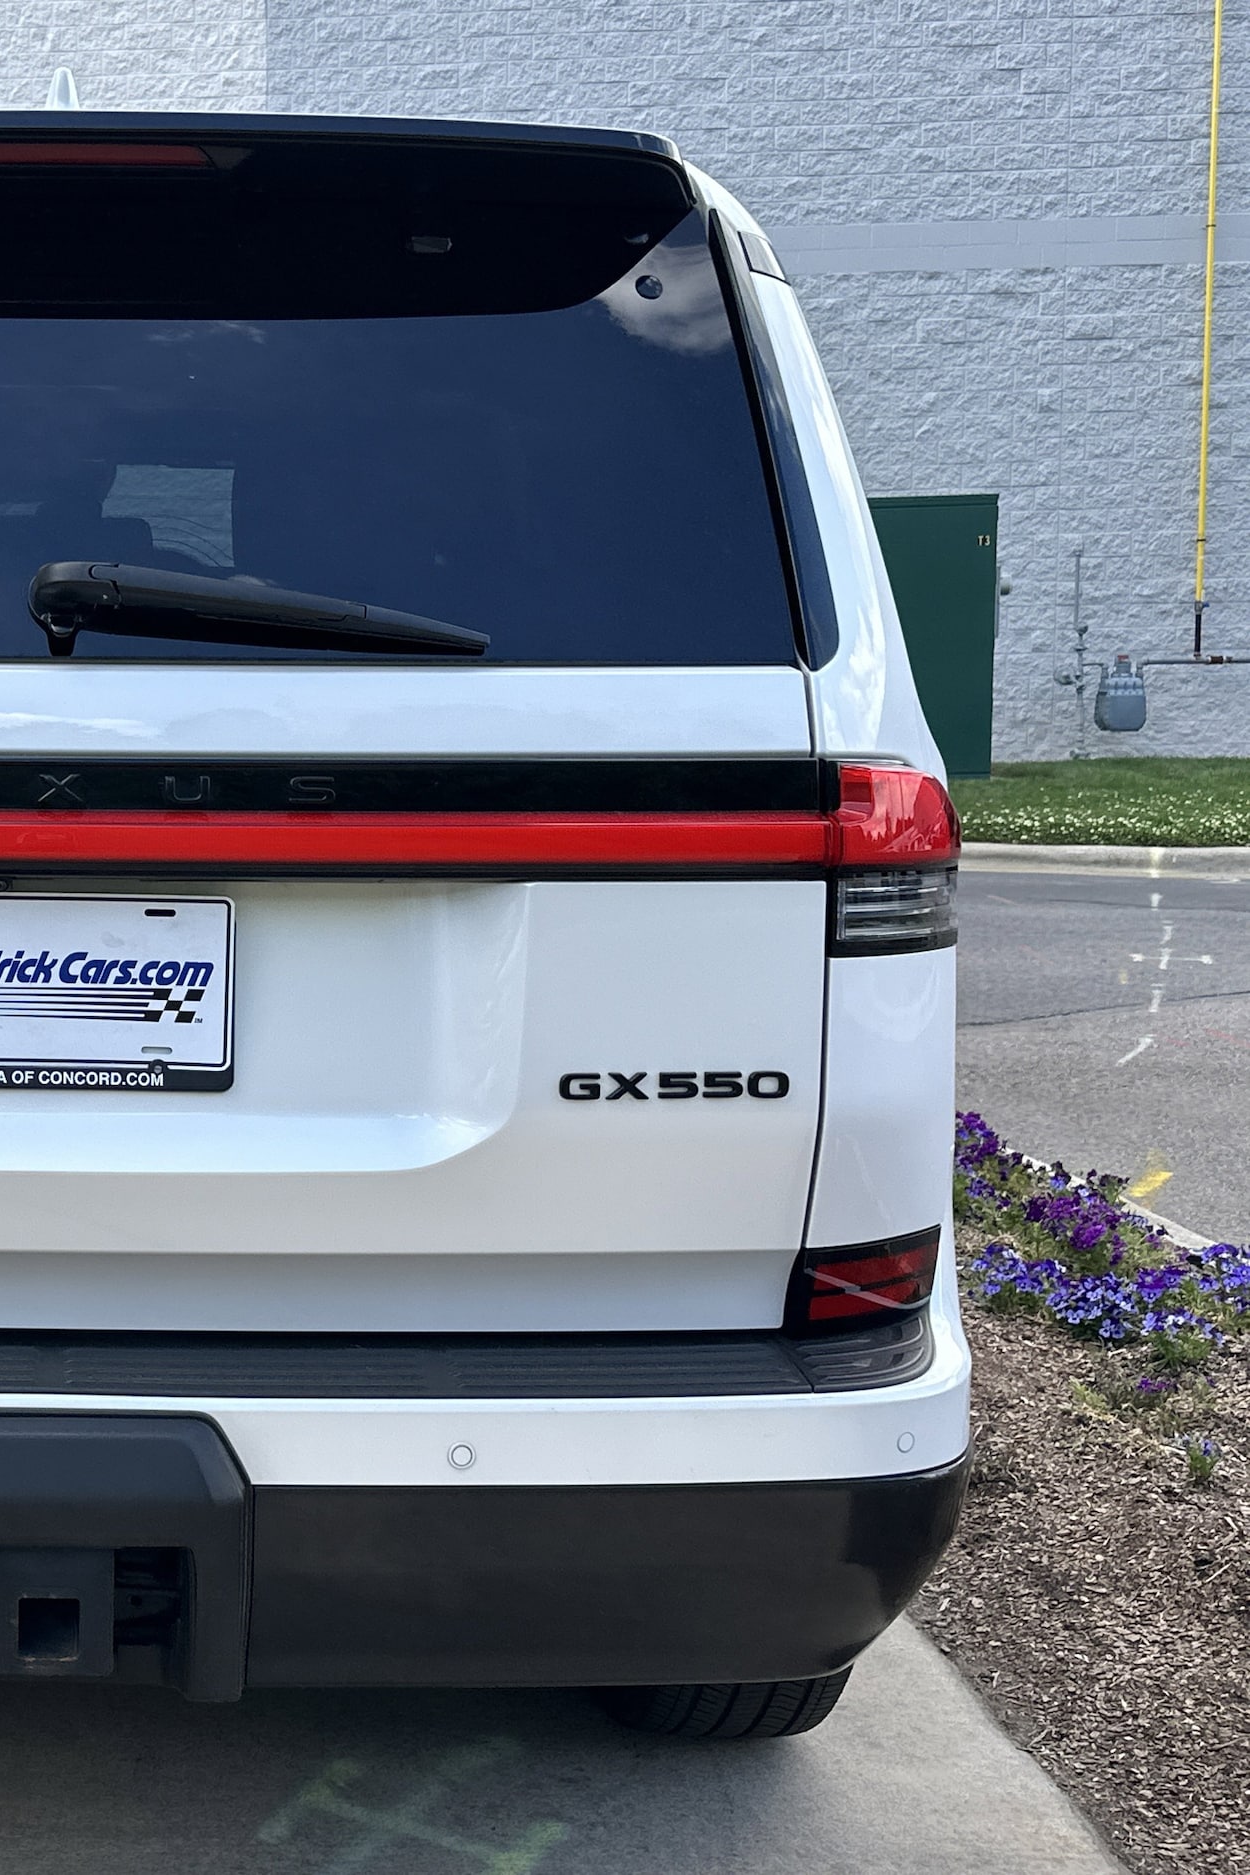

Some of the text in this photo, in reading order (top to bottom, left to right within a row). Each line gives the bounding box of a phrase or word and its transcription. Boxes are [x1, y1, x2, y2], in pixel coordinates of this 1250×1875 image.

[977, 534, 991, 546] T3
[11, 1071, 35, 1086] OF
[38, 1072, 165, 1088] CONCORD.COM
